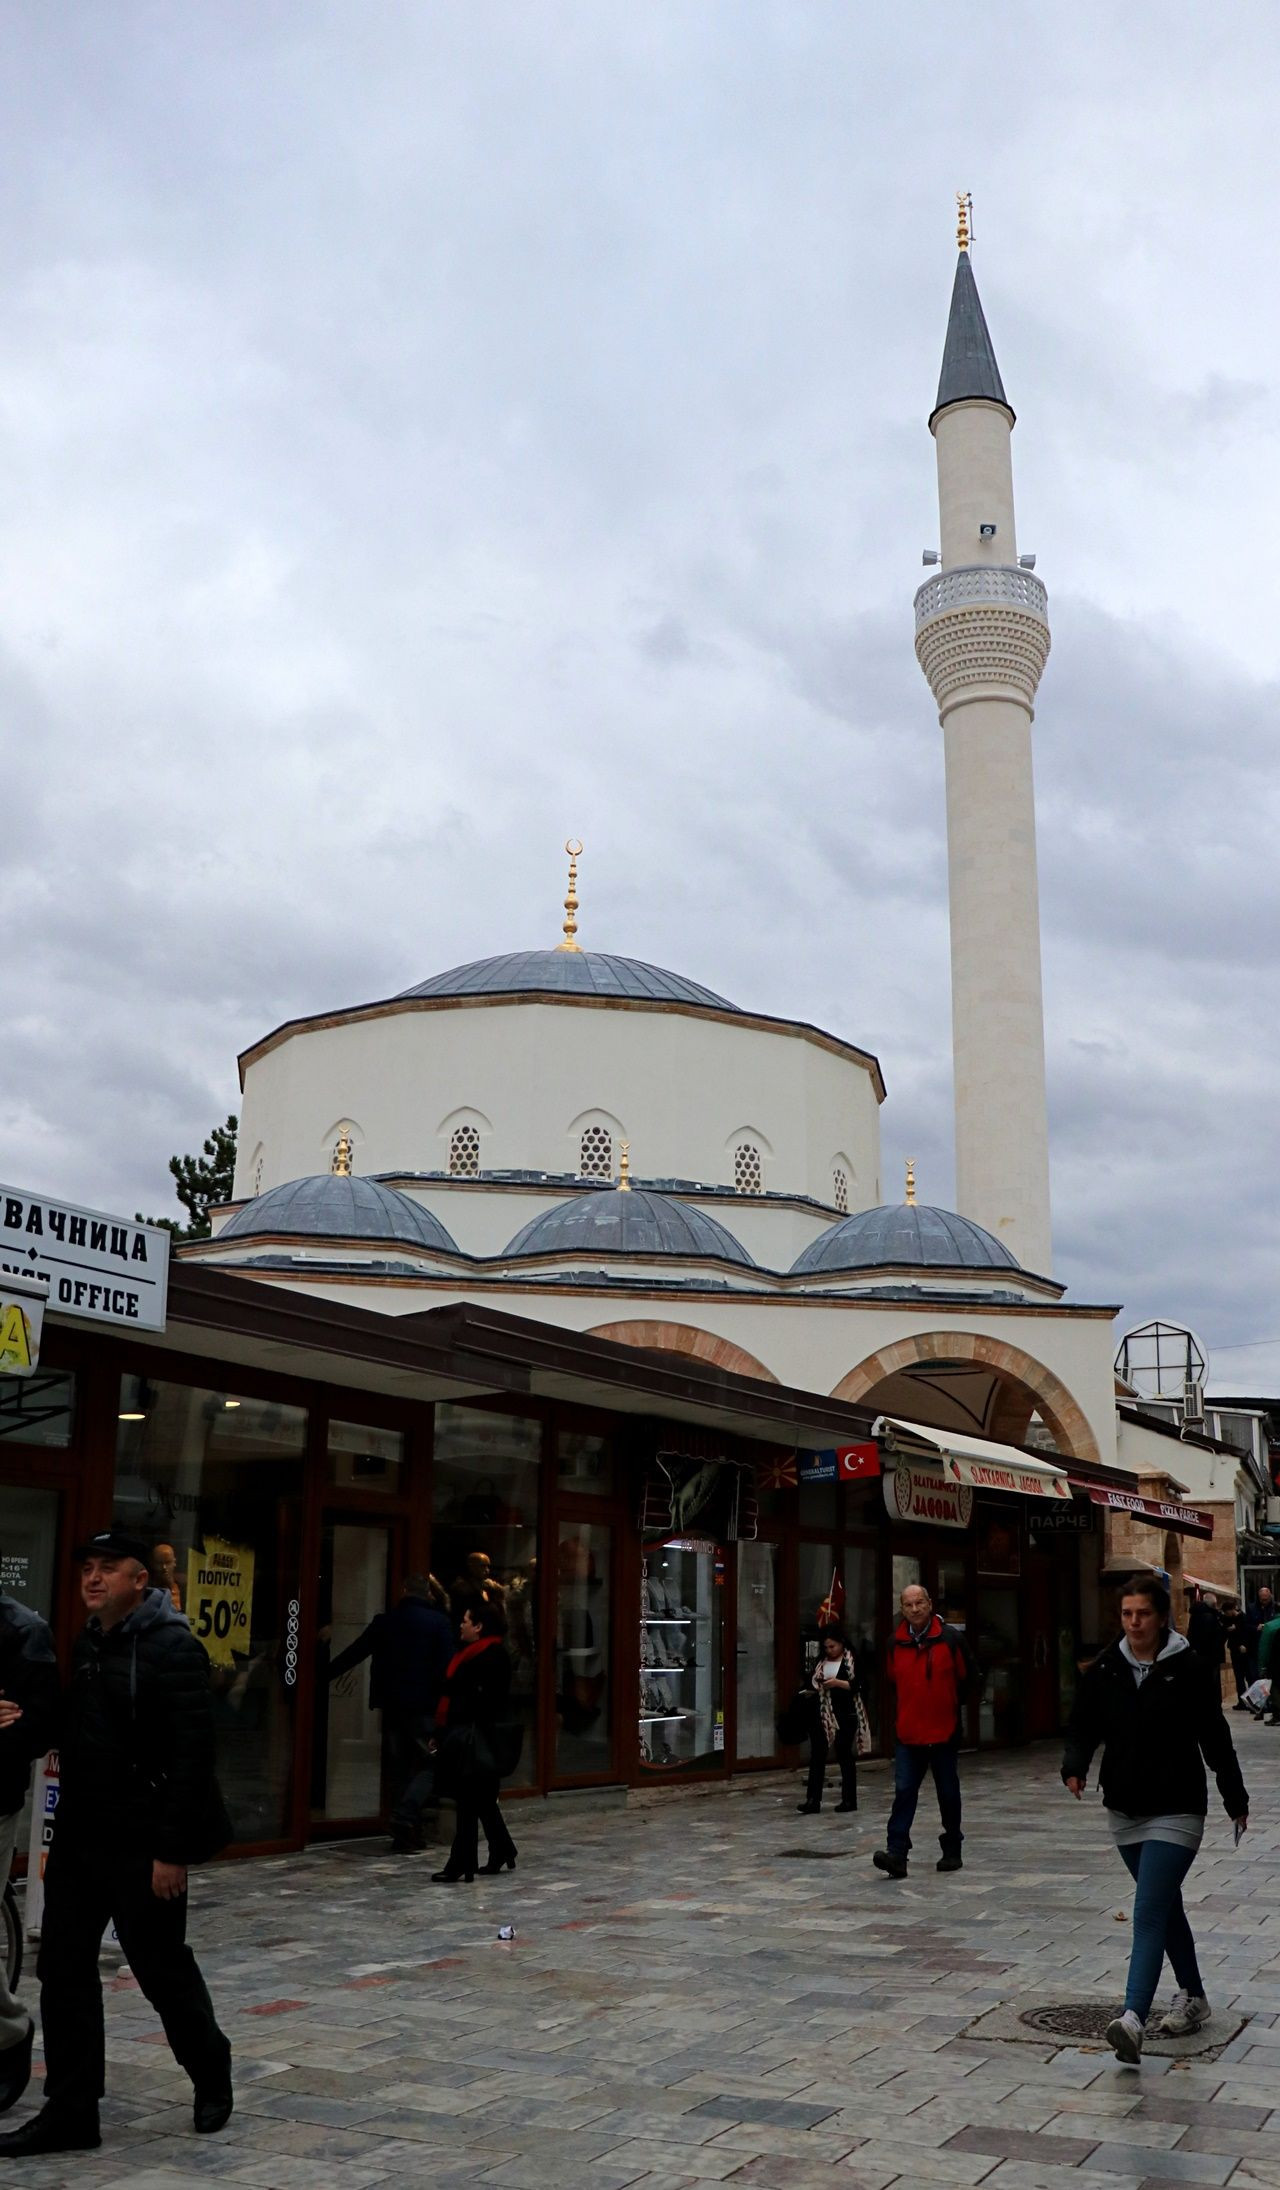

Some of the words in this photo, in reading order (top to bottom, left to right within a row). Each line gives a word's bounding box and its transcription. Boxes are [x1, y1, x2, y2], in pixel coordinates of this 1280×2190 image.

[0, 1195, 148, 1262] ВАЧНИЦА
[58, 1277, 139, 1318] OFFICE
[970, 1466, 1016, 1489] SLATKARNICA
[1019, 1475, 1043, 1494] JAGODA
[913, 1494, 958, 1522] JAGODA
[1107, 1493, 1125, 1507] FAST
[1126, 1497, 1145, 1512] FOOD
[1160, 1504, 1178, 1517] PIZZA
[1030, 1514, 1089, 1528] ПАРЧЕ
[197, 1569, 242, 1587] ПОПУСТ
[197, 1599, 247, 1638] 50%
